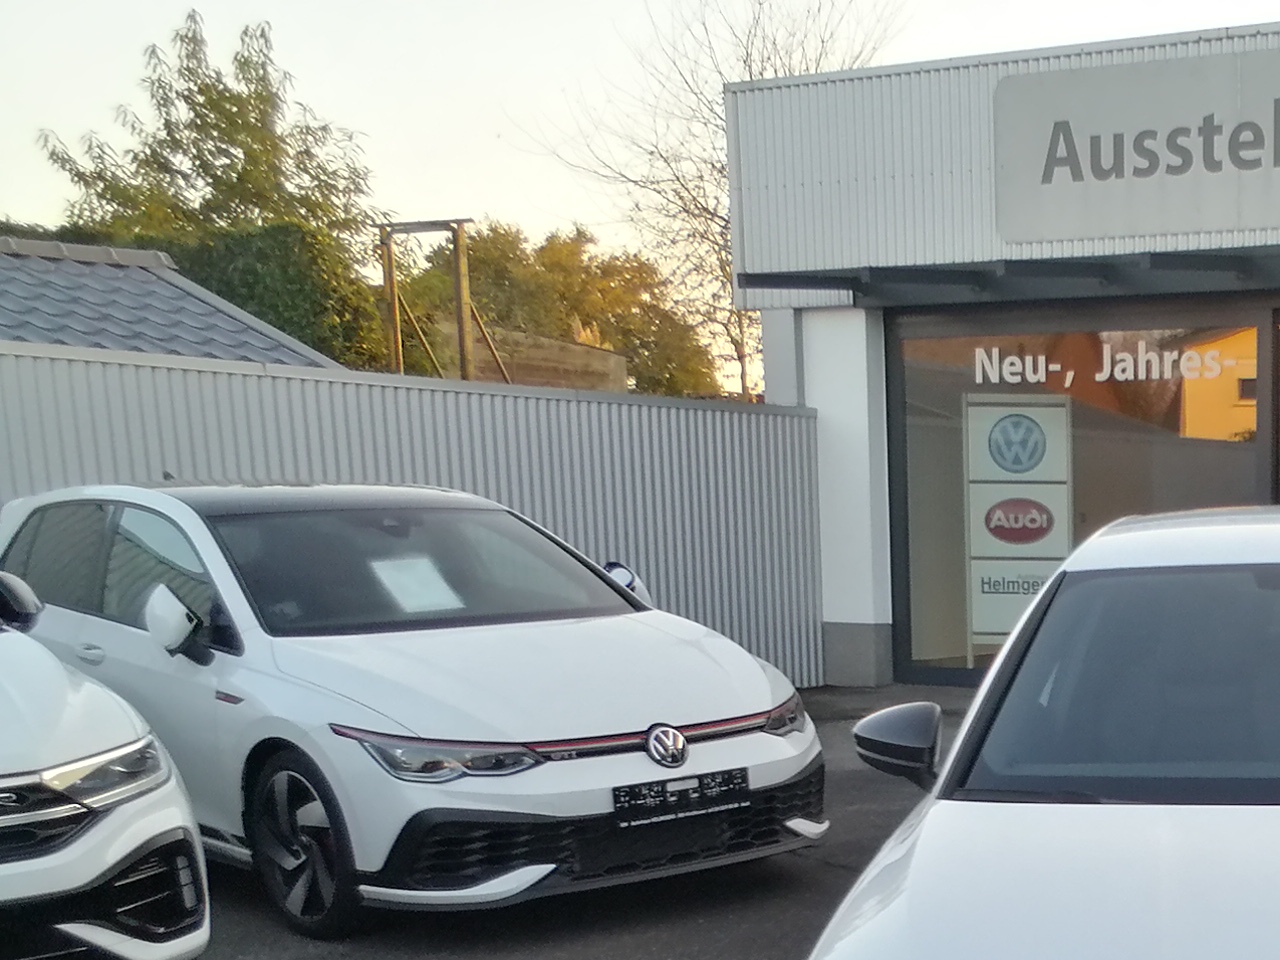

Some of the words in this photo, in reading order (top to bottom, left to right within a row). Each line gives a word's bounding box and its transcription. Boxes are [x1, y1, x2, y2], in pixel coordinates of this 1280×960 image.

[974, 347, 1075, 389] Neu-,
[1095, 340, 1238, 383] Jahres-
[989, 508, 1047, 529] Audi
[981, 576, 1047, 595] Helmge
